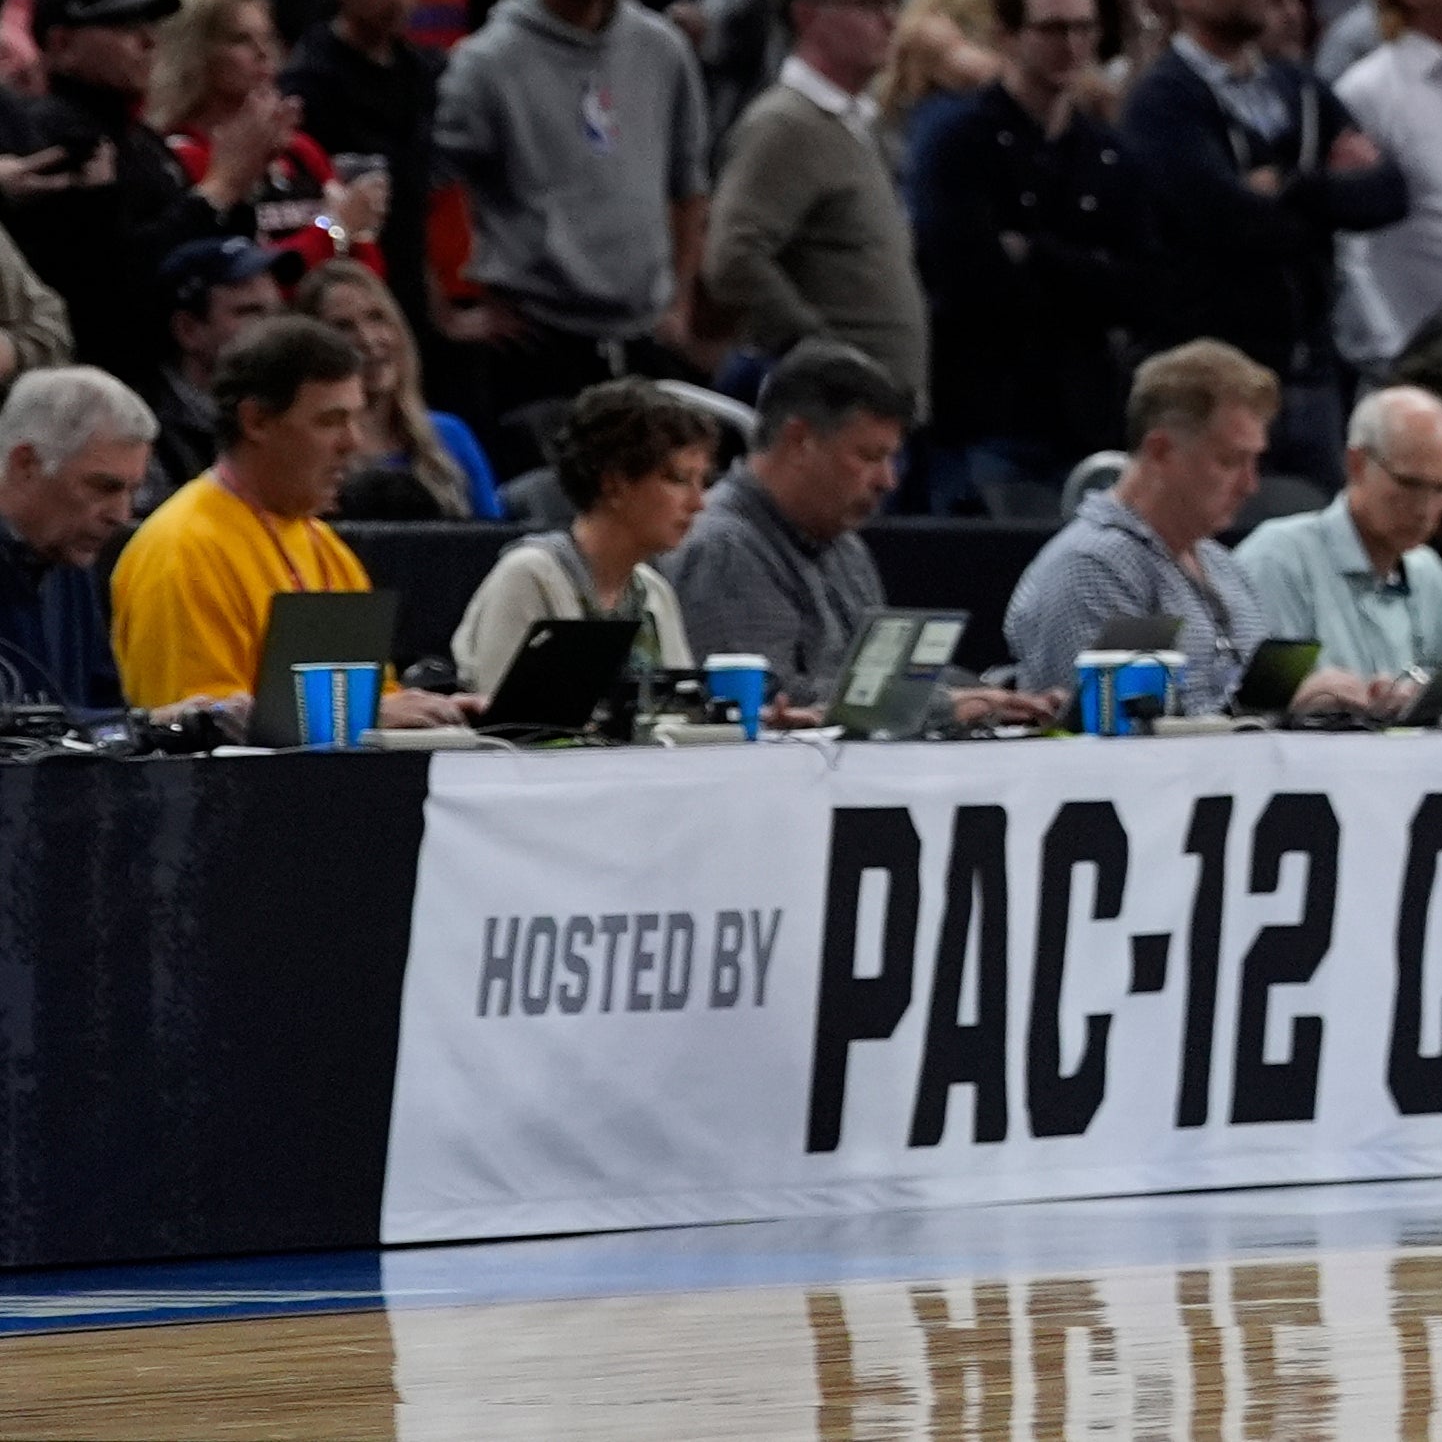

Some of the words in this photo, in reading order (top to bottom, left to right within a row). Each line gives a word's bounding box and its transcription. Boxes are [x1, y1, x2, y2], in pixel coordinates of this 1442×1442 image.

[475, 911, 697, 1018] HOSTED
[707, 908, 783, 1009] BY
[806, 792, 1342, 1154] PAC-12
